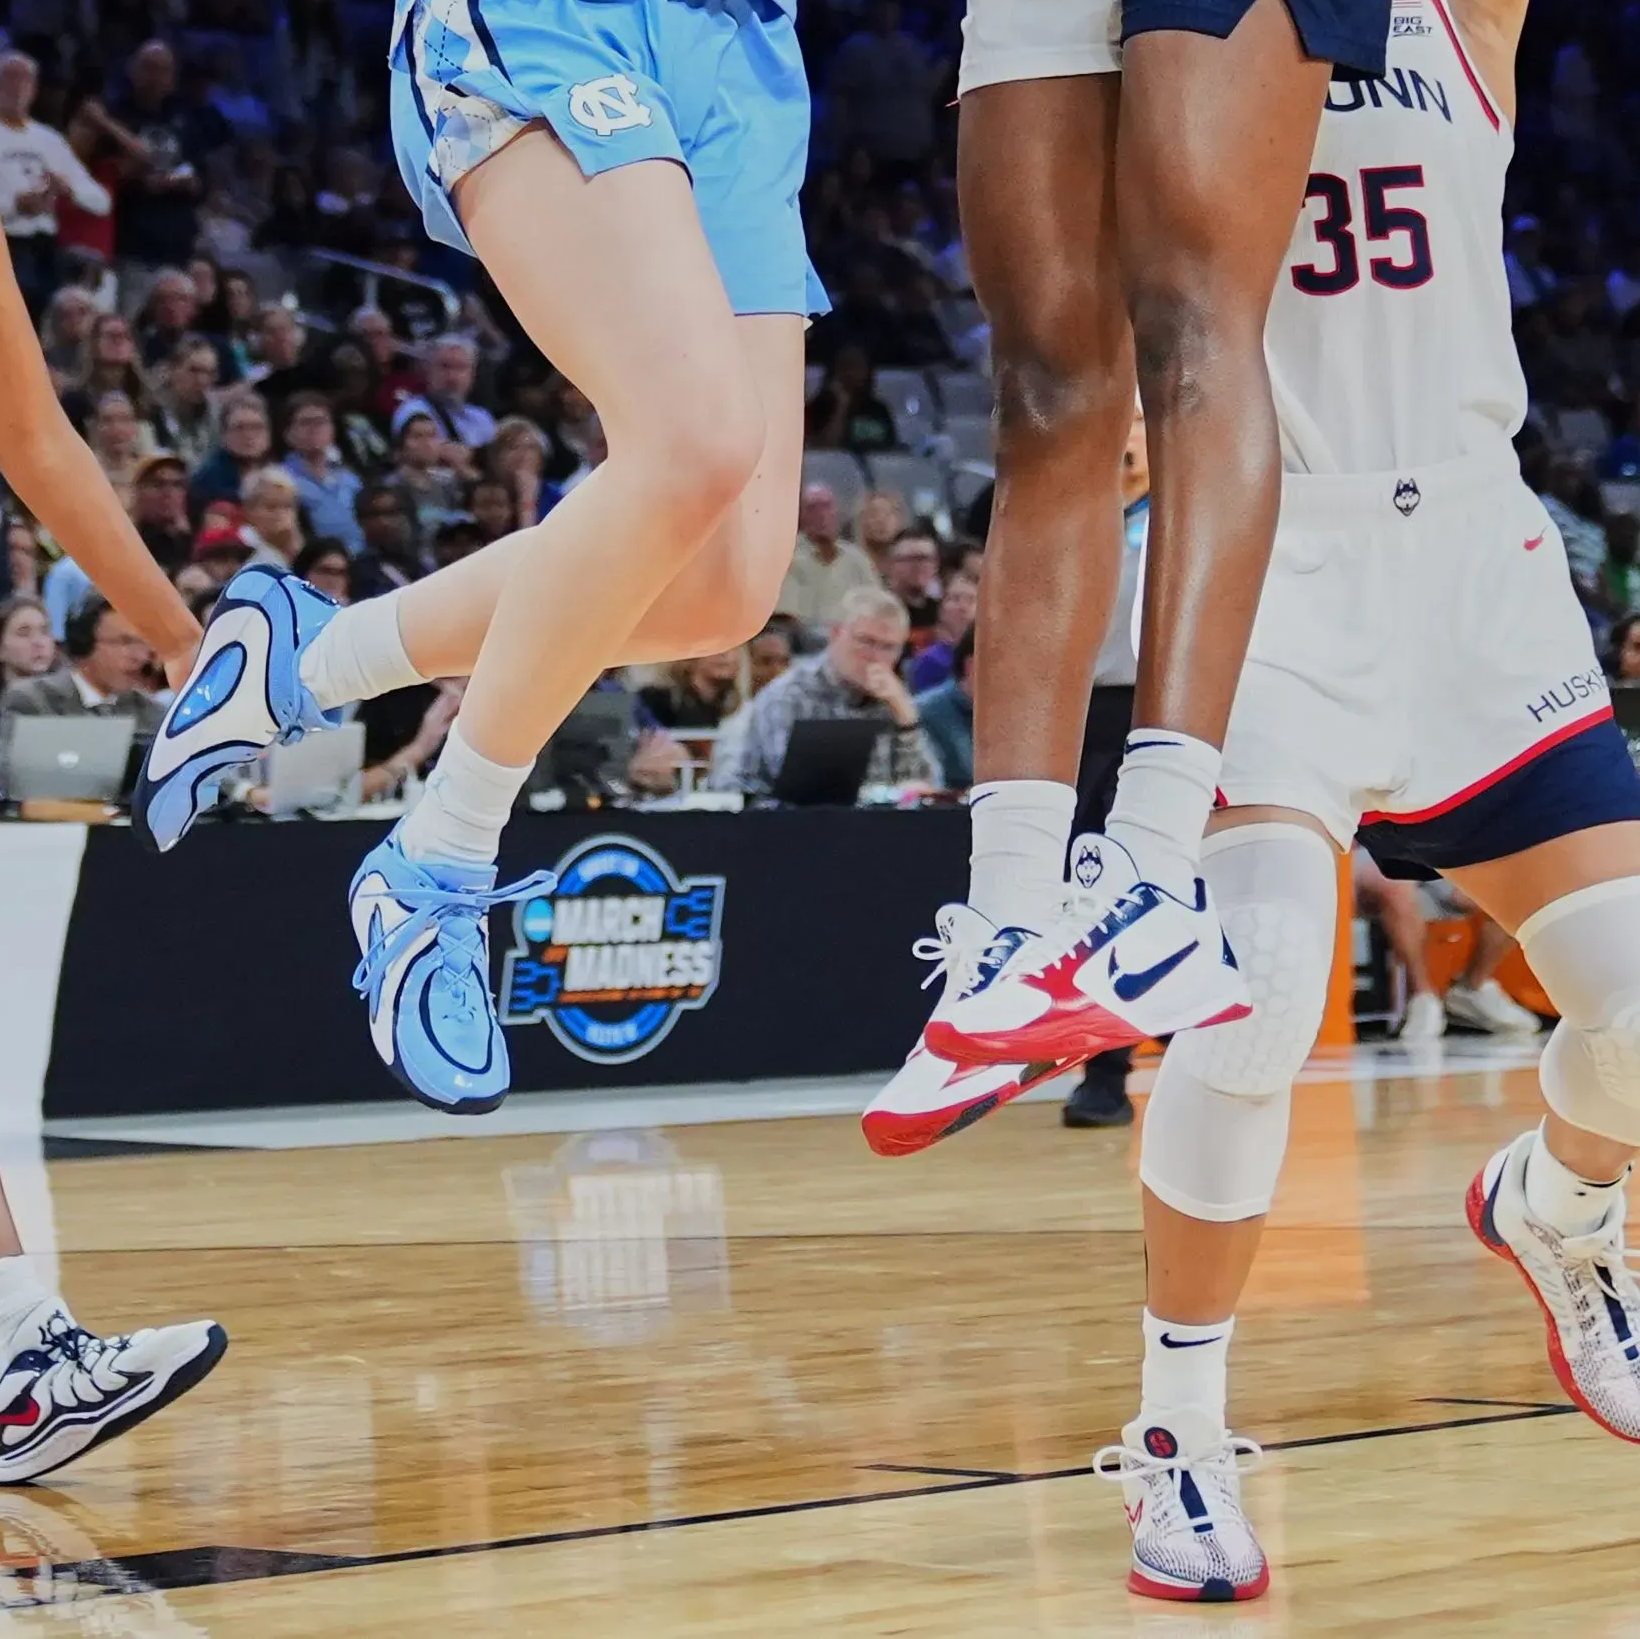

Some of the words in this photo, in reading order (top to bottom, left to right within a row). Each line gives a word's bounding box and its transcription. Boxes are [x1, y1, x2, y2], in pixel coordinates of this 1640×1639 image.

[1394, 16, 1423, 25] BIG
[1393, 25, 1434, 36] EAST
[1290, 164, 1435, 297] 35
